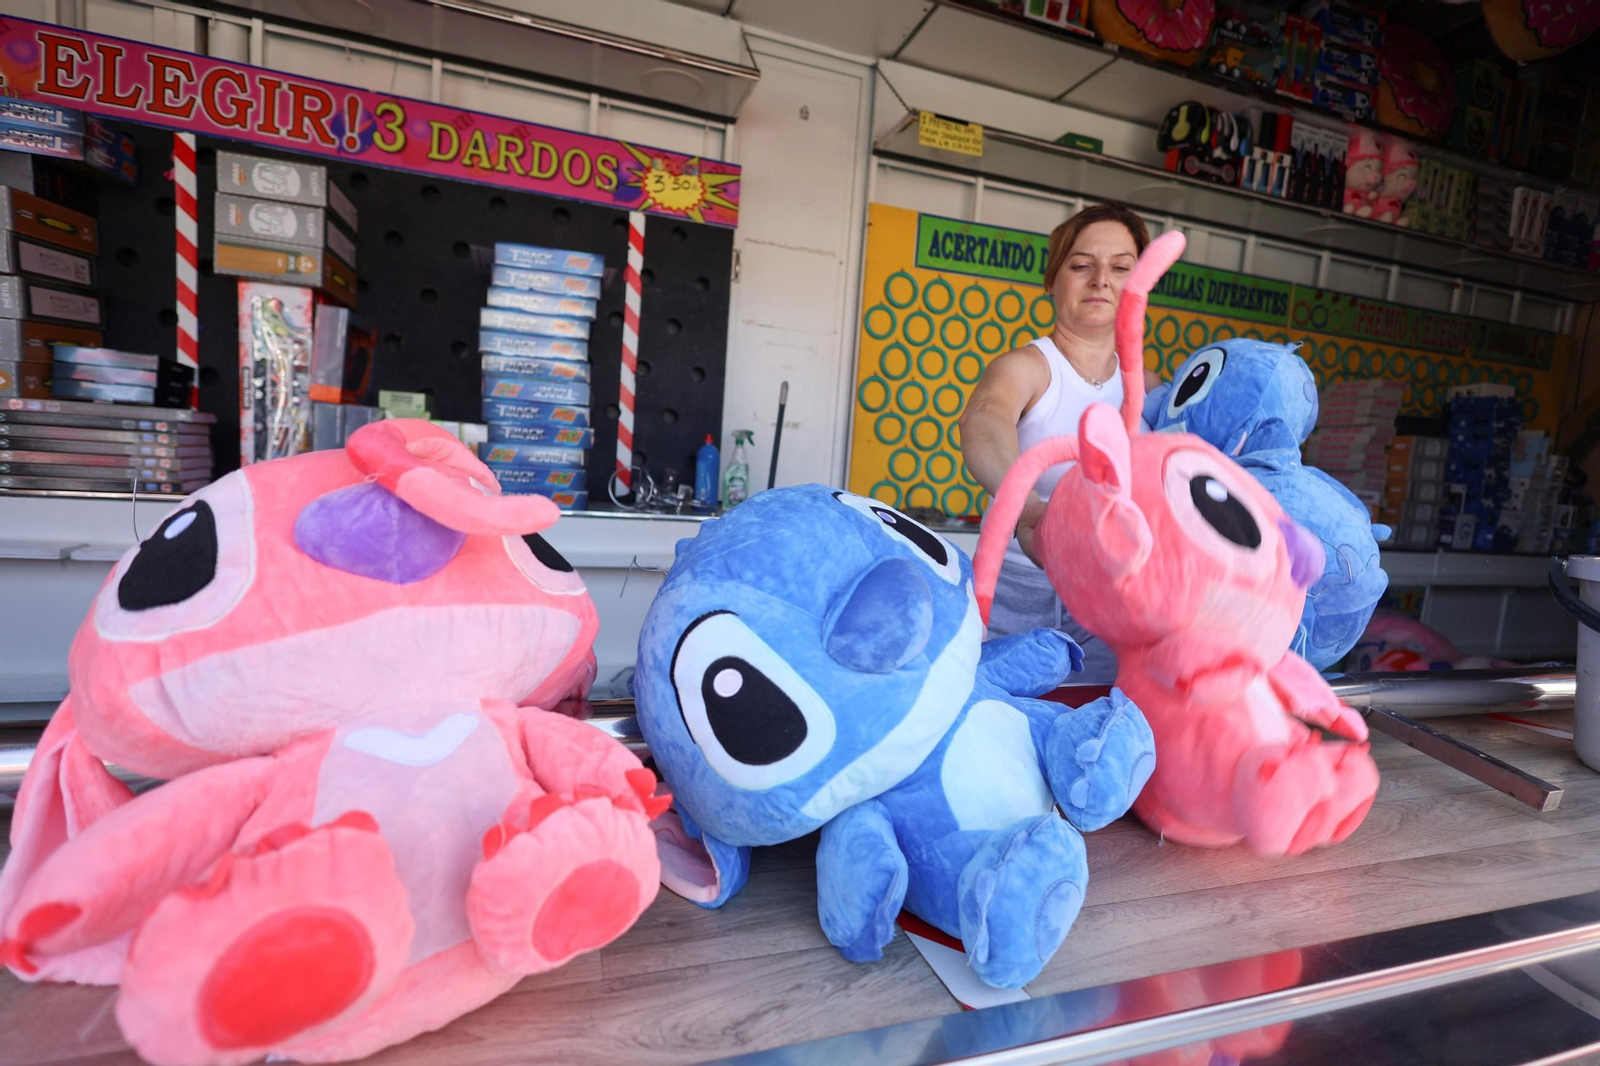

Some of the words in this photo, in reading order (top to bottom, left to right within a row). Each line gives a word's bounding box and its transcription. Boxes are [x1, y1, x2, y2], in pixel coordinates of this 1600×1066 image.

[37, 31, 361, 154] ELEGIR!
[372, 100, 407, 154] 3
[426, 119, 620, 193] DARDOS
[928, 229, 1035, 273] ACERTANDO
[1208, 279, 1289, 317] DIFERENTES
